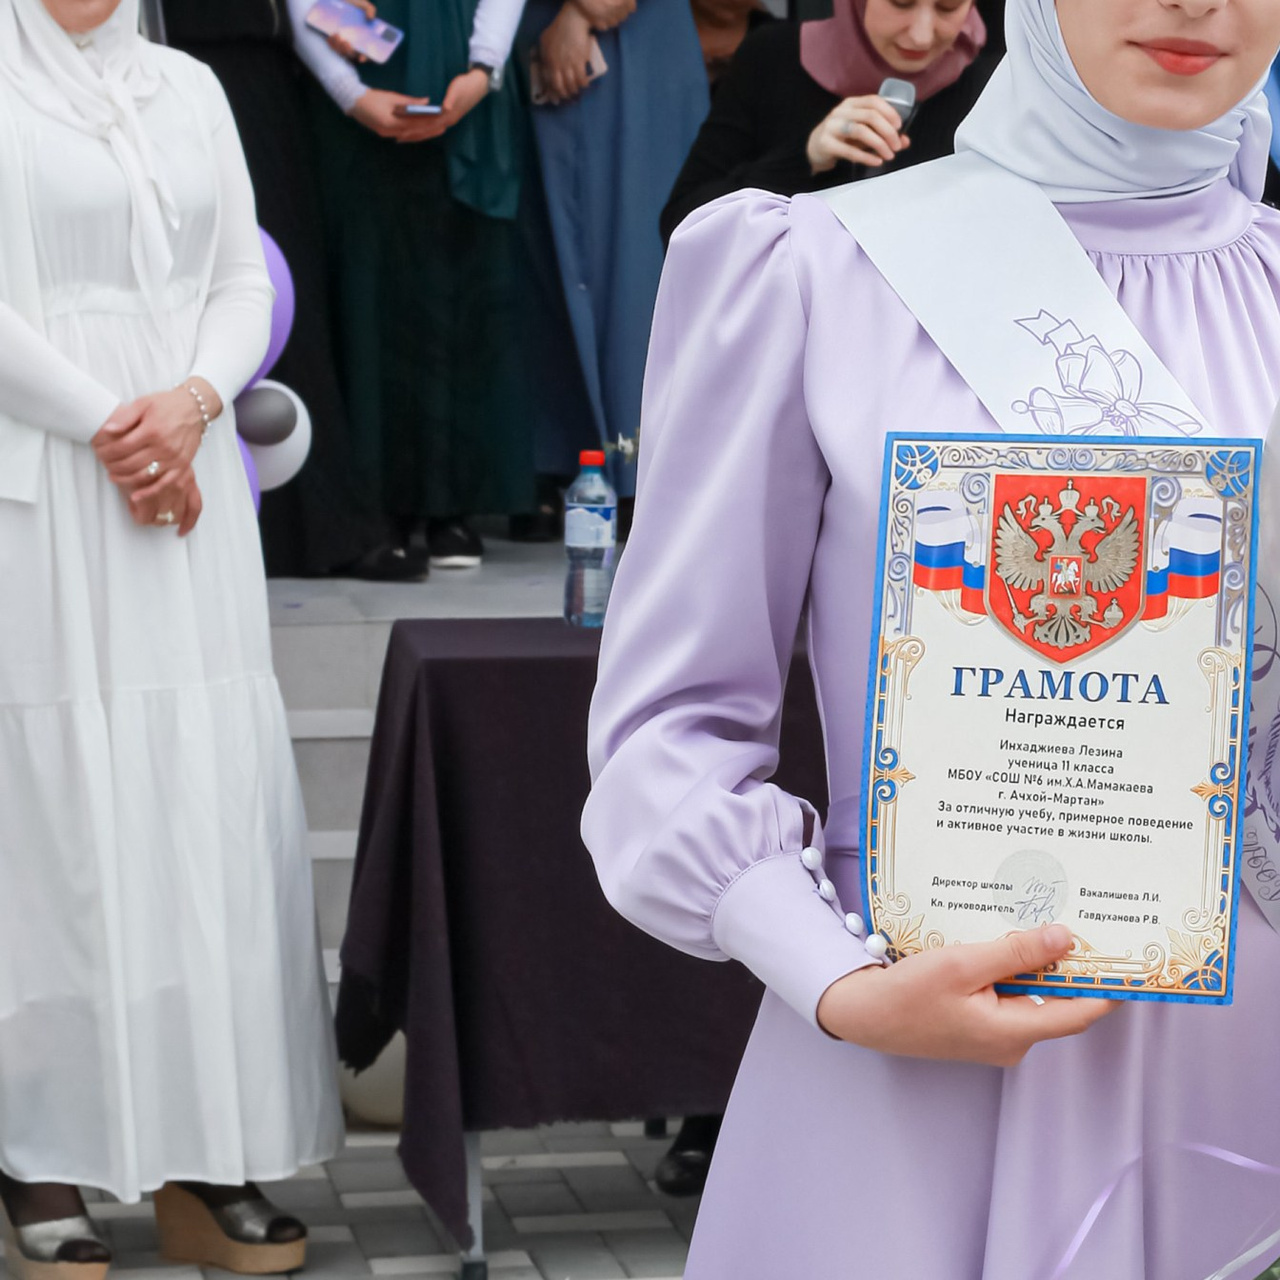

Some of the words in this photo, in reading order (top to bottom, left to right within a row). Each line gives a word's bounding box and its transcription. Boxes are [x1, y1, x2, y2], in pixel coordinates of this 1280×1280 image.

[950, 666, 1170, 705] ГРАМОТА
[1005, 708, 1125, 730] Награждается
[999, 739, 1076, 755] Инхаджиева
[1079, 744, 1123, 758] Лезина
[1008, 758, 1058, 771] ученица
[1062, 760, 1070, 771] 11
[1073, 763, 1114, 774] класса
[947, 768, 982, 781] МБОУ
[985, 771, 1020, 784] «СОШ
[1024, 774, 1043, 785] №6
[1046, 776, 1154, 794] им.Х.А.Мамакаева
[998, 791, 1006, 800] г.
[1010, 789, 1104, 807] Ачхой-Мартан»
[937, 800, 952, 812] За
[955, 804, 1015, 818] отличную
[1018, 808, 1055, 822] учебу,
[1059, 811, 1124, 826] примерное
[1128, 817, 1194, 830] поведение
[936, 819, 944, 828] и
[947, 820, 1003, 832] активное
[1007, 824, 1054, 836] участие
[1058, 828, 1065, 837] в
[1068, 829, 1106, 840] жизни
[1109, 832, 1153, 844] школы.
[931, 876, 978, 890] Директор
[980, 882, 1013, 891] школы
[1142, 892, 1162, 902] Л.И.
[931, 898, 945, 908] Кл.
[948, 901, 1015, 913] руководитель
[1142, 914, 1161, 925] Р.В.
